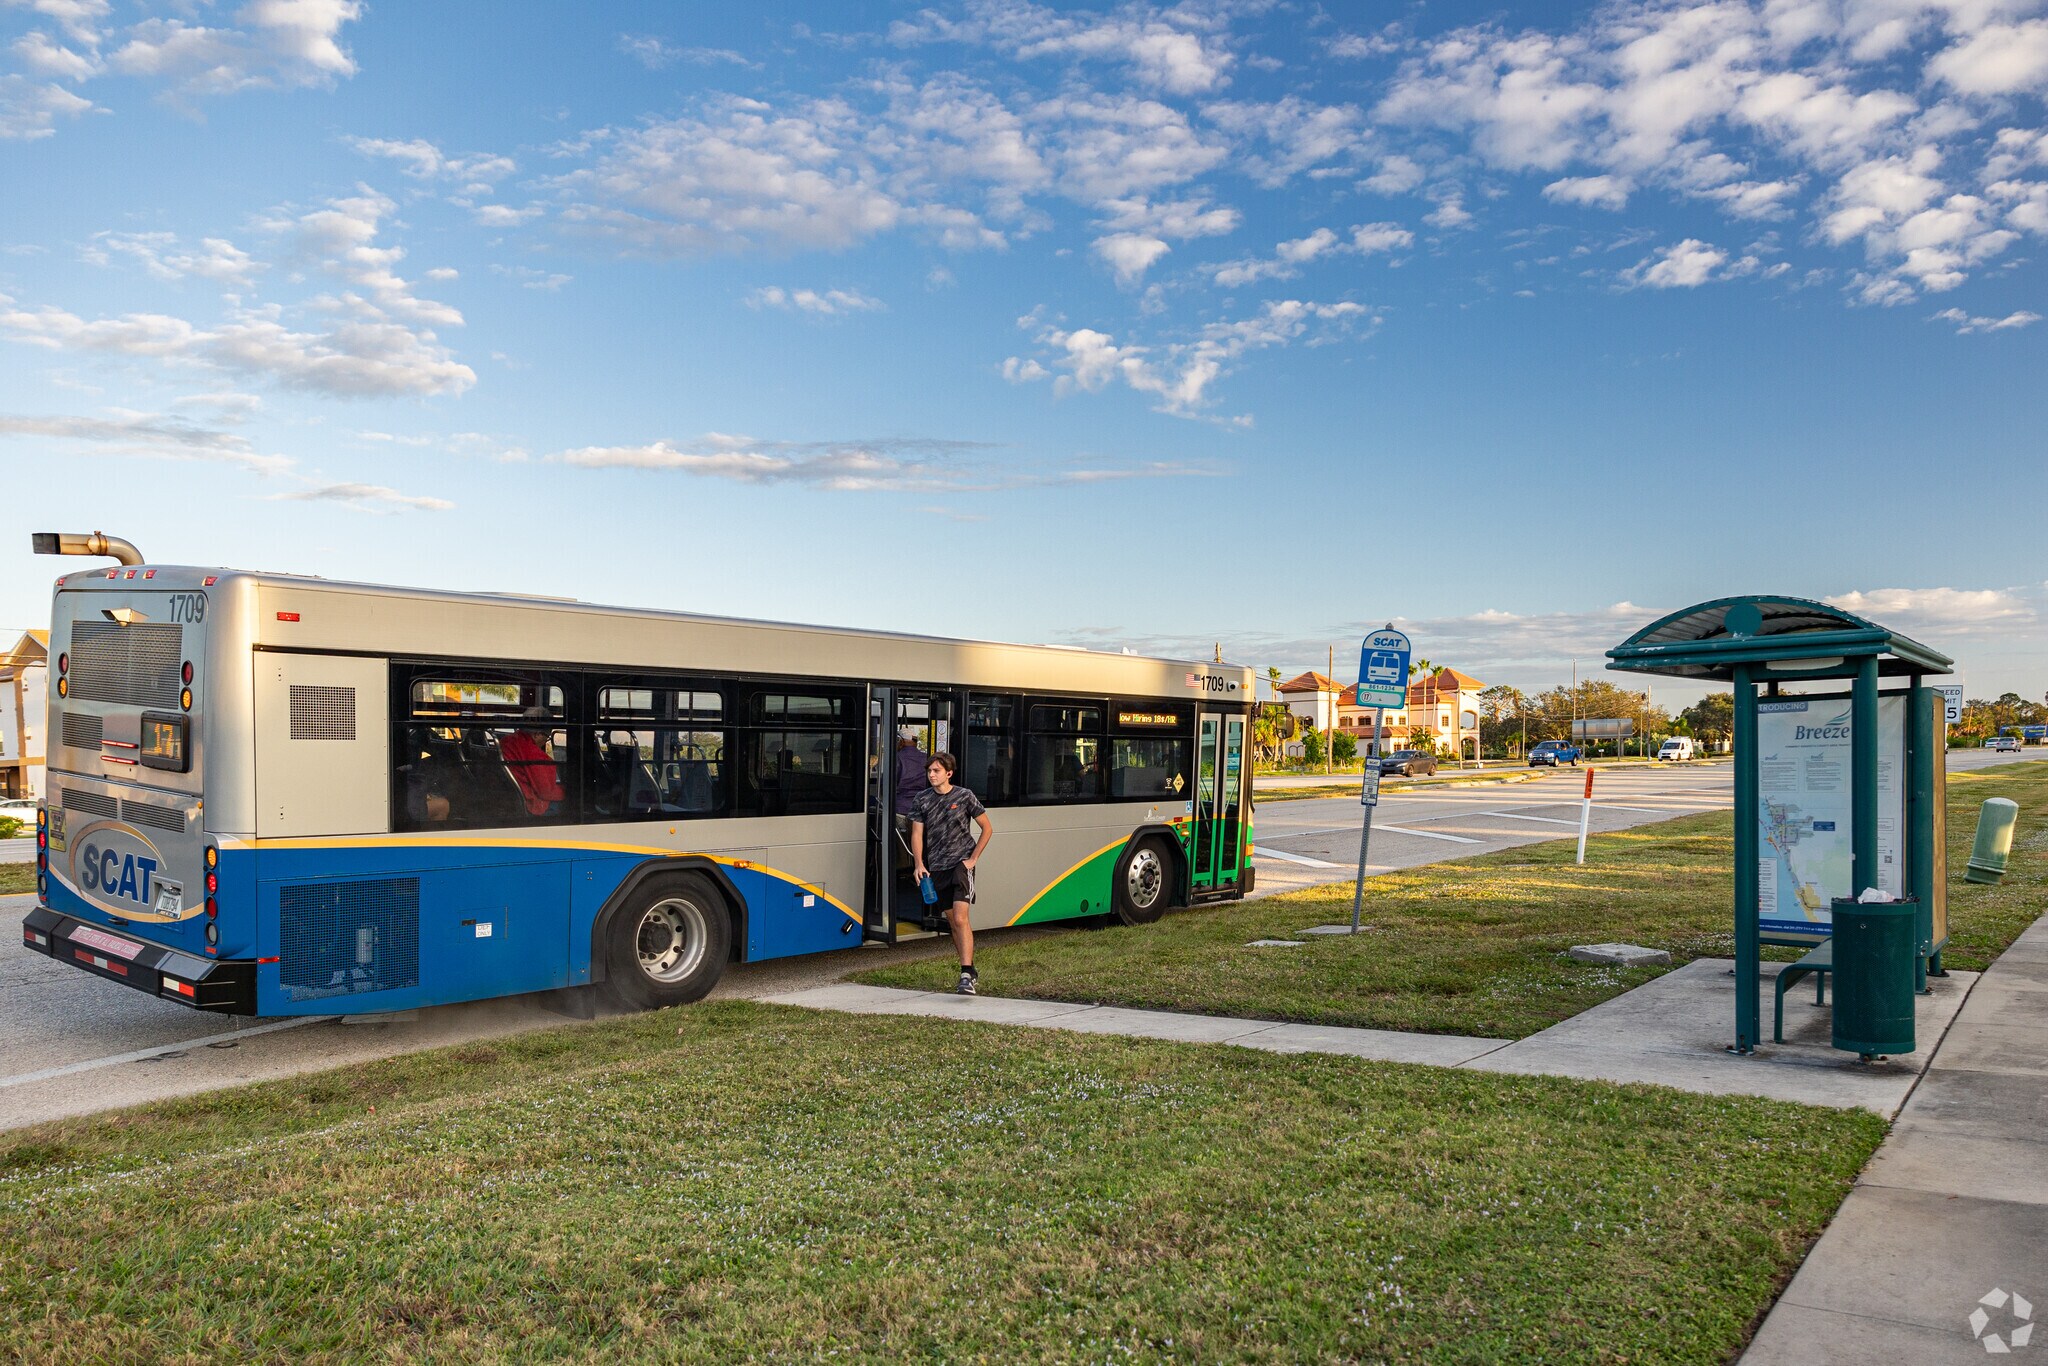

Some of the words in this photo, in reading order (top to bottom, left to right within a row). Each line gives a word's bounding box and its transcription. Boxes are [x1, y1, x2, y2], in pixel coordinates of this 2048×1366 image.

[169, 594, 205, 624] 1709
[1373, 637, 1402, 647] SCAT
[1201, 676, 1224, 692] 1709
[1759, 702, 1806, 712] TRODUCING
[1946, 707, 1957, 719] 5
[1132, 714, 1152, 723] Hiring
[1153, 715, 1176, 724] 18$/HR
[153, 722, 174, 758] 17
[1795, 725, 1850, 740] Breeze
[82, 842, 158, 906] SCAT
